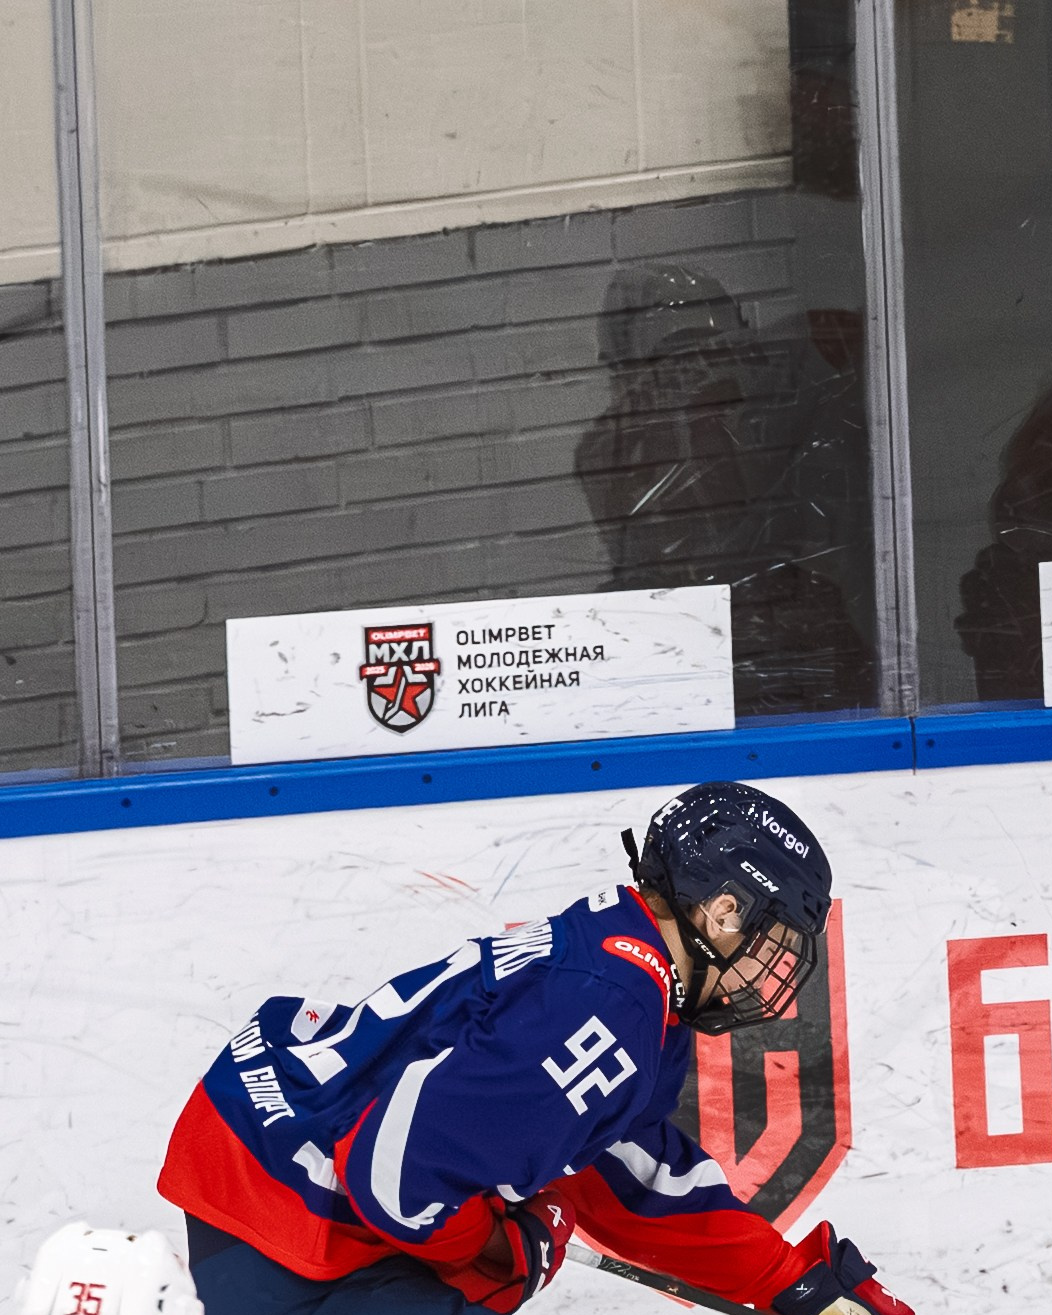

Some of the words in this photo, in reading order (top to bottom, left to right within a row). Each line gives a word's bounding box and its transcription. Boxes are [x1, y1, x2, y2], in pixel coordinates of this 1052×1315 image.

[370, 628, 427, 641] OLIMPBET
[456, 624, 556, 646] OLIMPBET
[368, 641, 431, 664] МХЛ
[457, 645, 605, 670] МОЛОДЕЖНАЯ
[458, 670, 581, 694] ХОККЕЙНАЯ
[458, 701, 510, 718] ЛИГА
[761, 811, 810, 859] Vorgol
[739, 860, 780, 893] CCM
[694, 937, 716, 960] CCM
[541, 1014, 638, 1116] 92
[239, 1065, 296, 1127] СПОРТ
